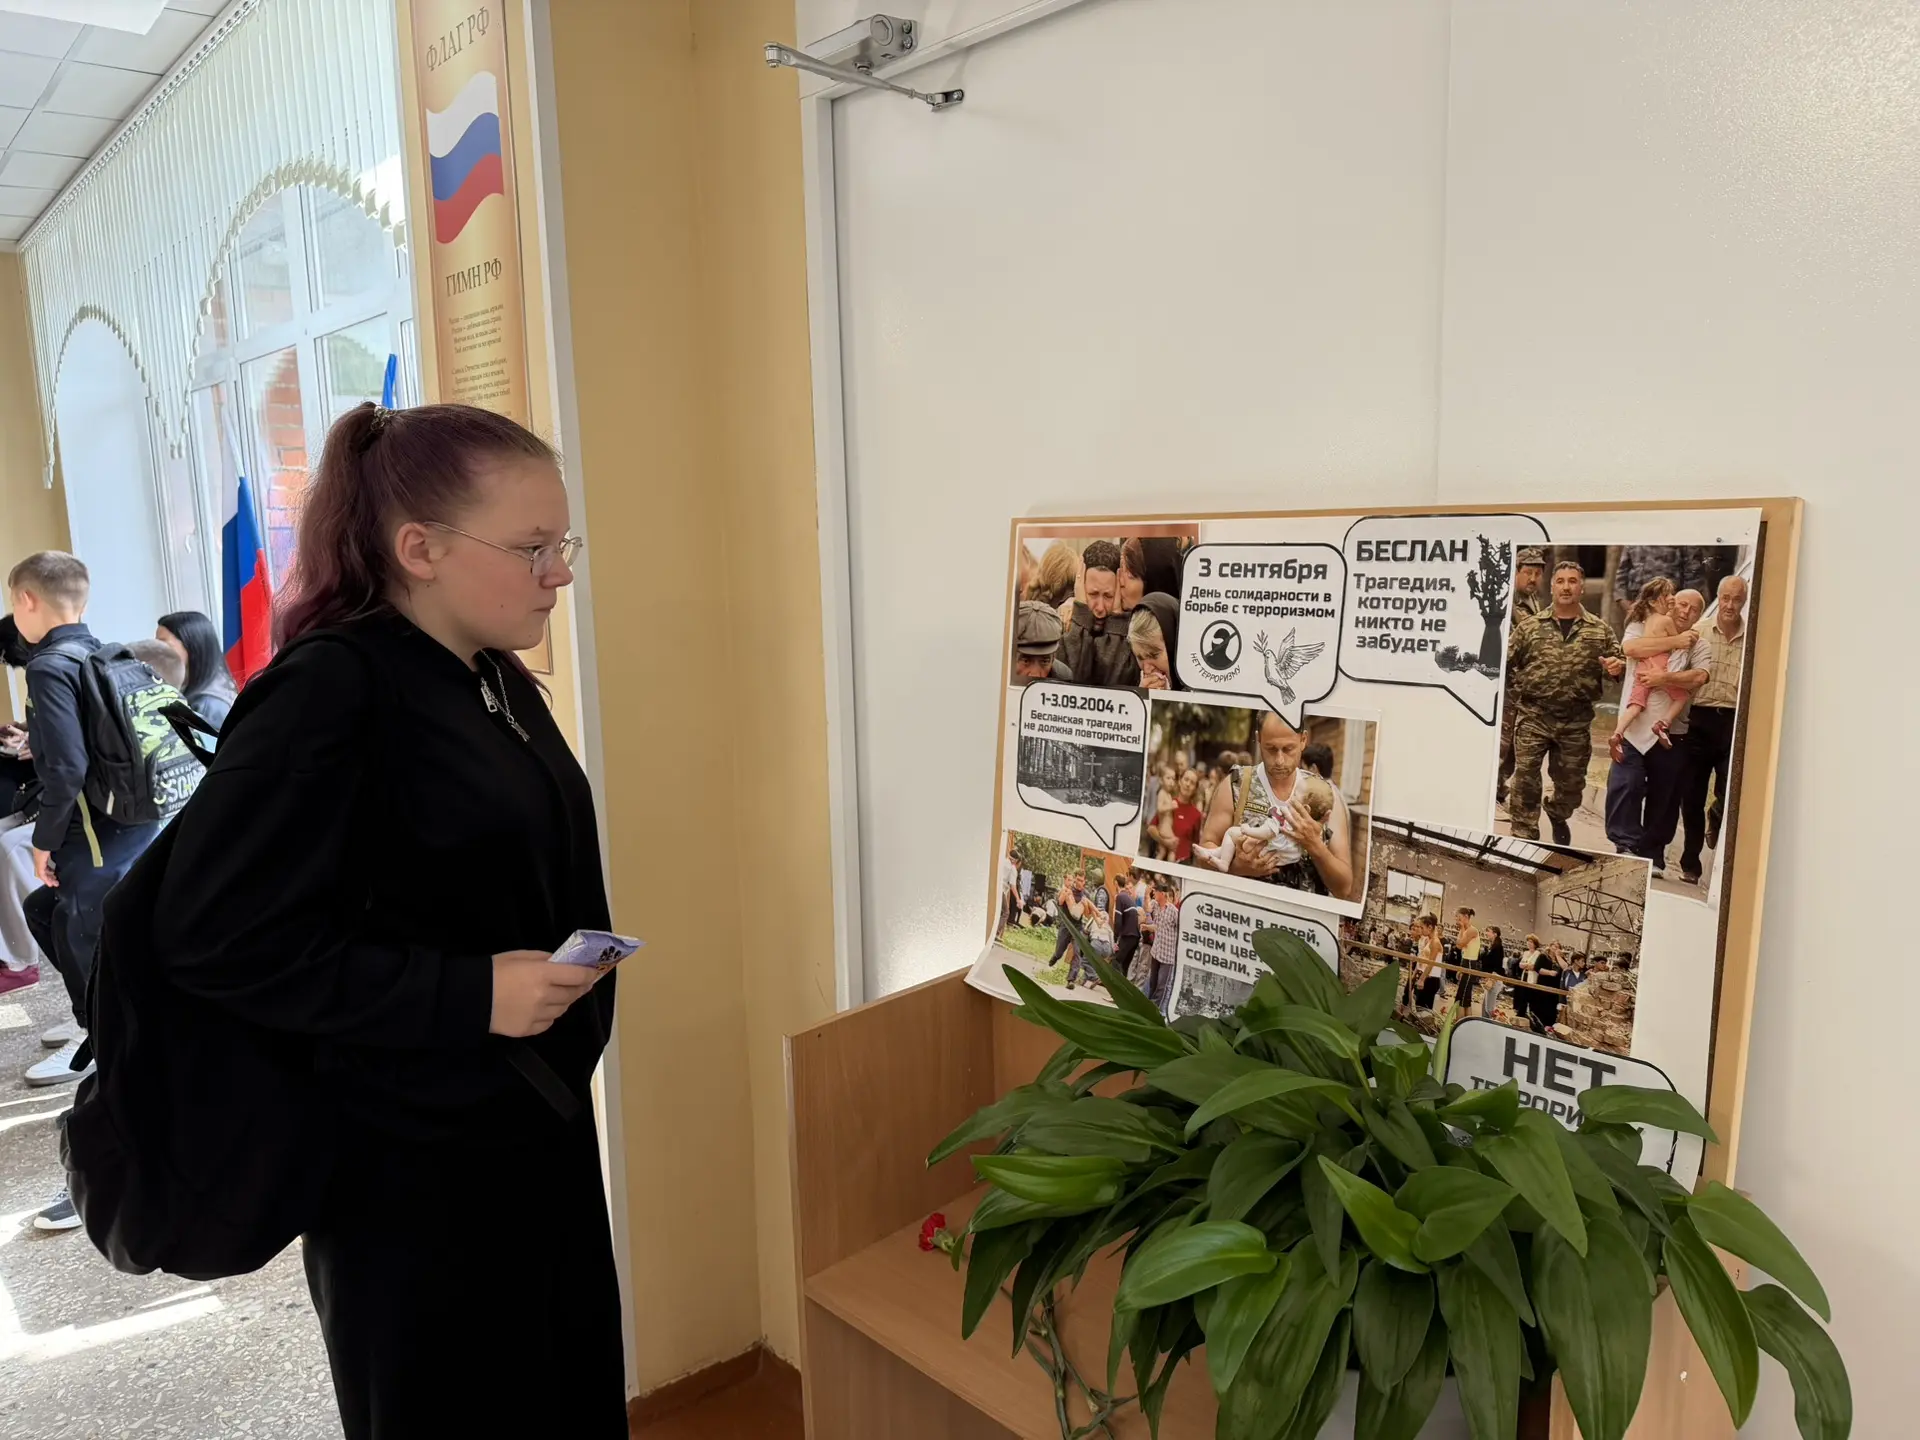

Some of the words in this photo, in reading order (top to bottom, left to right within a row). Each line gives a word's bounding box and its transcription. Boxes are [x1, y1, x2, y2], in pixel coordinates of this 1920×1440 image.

[426, 22, 464, 71] ФЛАГ
[467, 6, 490, 44] РФ
[446, 265, 481, 297] ГИМН
[484, 258, 502, 284] РФ
[1356, 540, 1468, 562] БЕСЛАН
[1199, 558, 1212, 577] 3
[1218, 558, 1328, 584] сентября
[1353, 573, 1456, 593] Трагедия,
[1189, 586, 1221, 599] День
[1225, 589, 1319, 603] солидарности
[1323, 593, 1332, 602] в
[1357, 596, 1447, 614] которую
[1184, 600, 1228, 614] борьбе
[1232, 604, 1239, 613] с
[1242, 605, 1335, 618] терроризмом
[1354, 615, 1414, 631] никто
[1420, 618, 1446, 632] не
[1356, 633, 1441, 653] забудет
[1190, 652, 1200, 667] НЕТ
[1199, 665, 1241, 683] ТЕРРОРИЗМУ
[1040, 692, 1114, 713] 1-3.09.2004
[1118, 704, 1128, 715] г.
[1030, 710, 1083, 725] Бесланская
[1086, 718, 1132, 732] трагедия
[1023, 721, 1035, 730] не
[1037, 723, 1073, 735] должна
[1075, 729, 1141, 745] повториться!
[1196, 903, 1251, 927] «Зачем
[1255, 919, 1264, 929] в
[1194, 919, 1239, 940] зачем
[1182, 931, 1226, 952] зачем
[1230, 944, 1262, 962] цве
[1502, 1036, 1616, 1096] НЕТ
